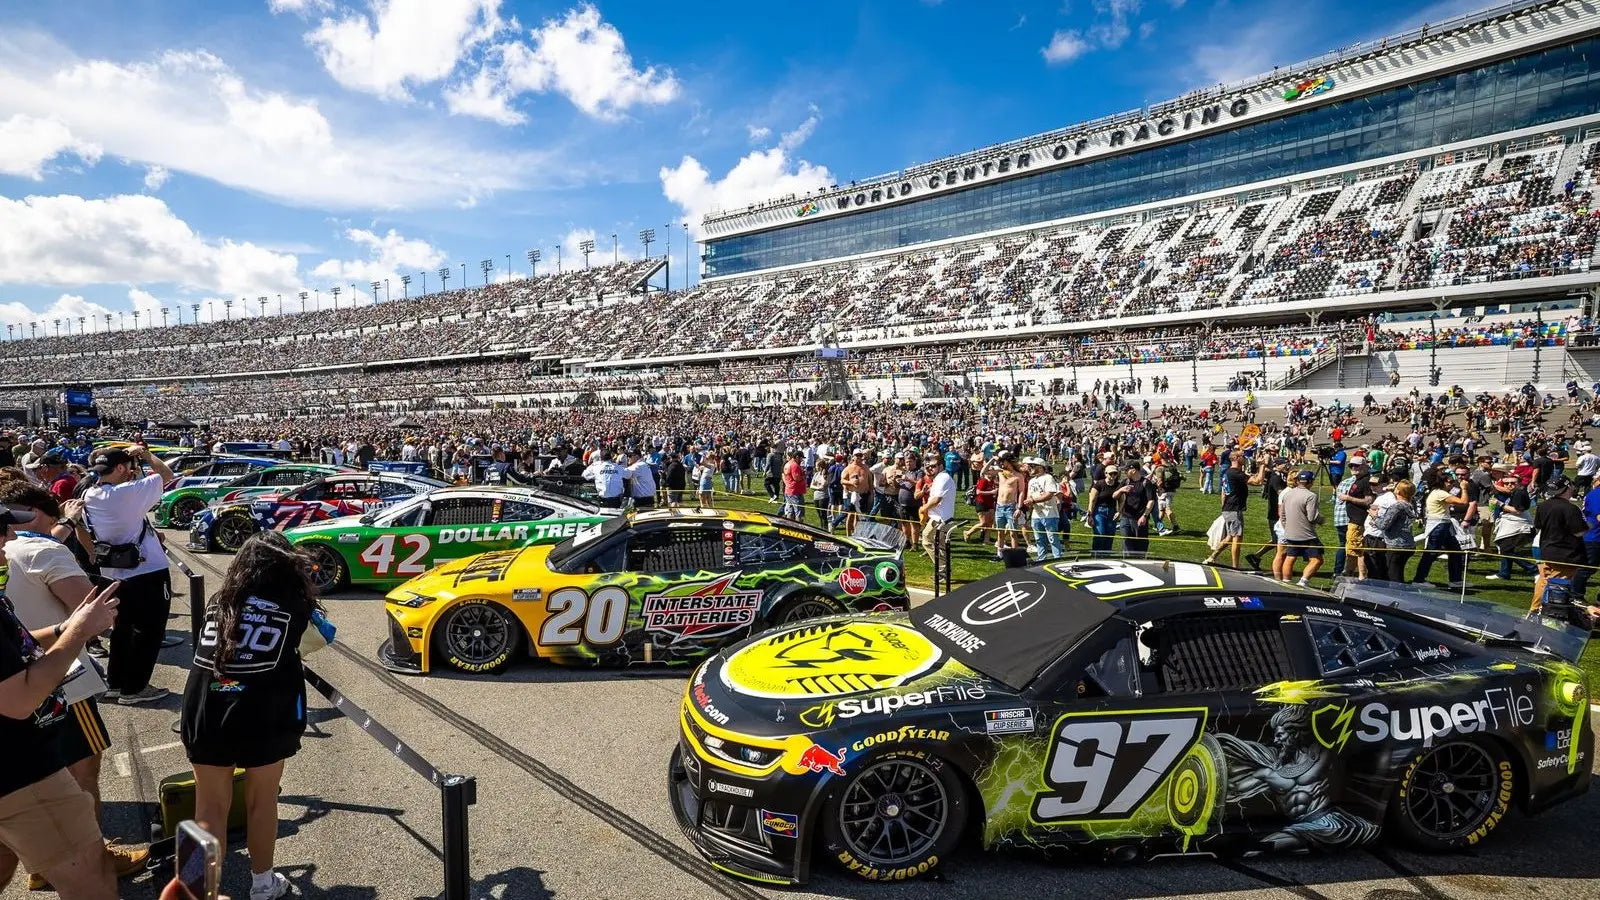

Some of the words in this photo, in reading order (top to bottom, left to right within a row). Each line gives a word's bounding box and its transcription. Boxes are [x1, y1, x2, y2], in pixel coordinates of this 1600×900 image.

[837, 181, 912, 210] WORLD
[928, 154, 1031, 190] CENTER
[1053, 137, 1088, 160] OF
[1109, 99, 1249, 148] RACING
[438, 525, 529, 544] DOLLAR
[360, 533, 432, 575] 42
[841, 569, 866, 591] Rheem
[649, 594, 758, 611] INTERSTATE
[1204, 597, 1237, 606] SVG
[1305, 605, 1343, 618] SIEMENS
[541, 587, 629, 646] 20
[653, 610, 752, 626] BATTERIES
[923, 613, 986, 654] TRACKHOUSE
[838, 684, 987, 719] SuperFile
[1000, 710, 1026, 720] NASCAR
[1356, 686, 1535, 748] SuperFile
[852, 724, 950, 753] GOODYEAR
[1037, 717, 1198, 819] 97
[1466, 761, 1513, 845] GOODYEAR
[764, 819, 796, 830] SUNOCO
